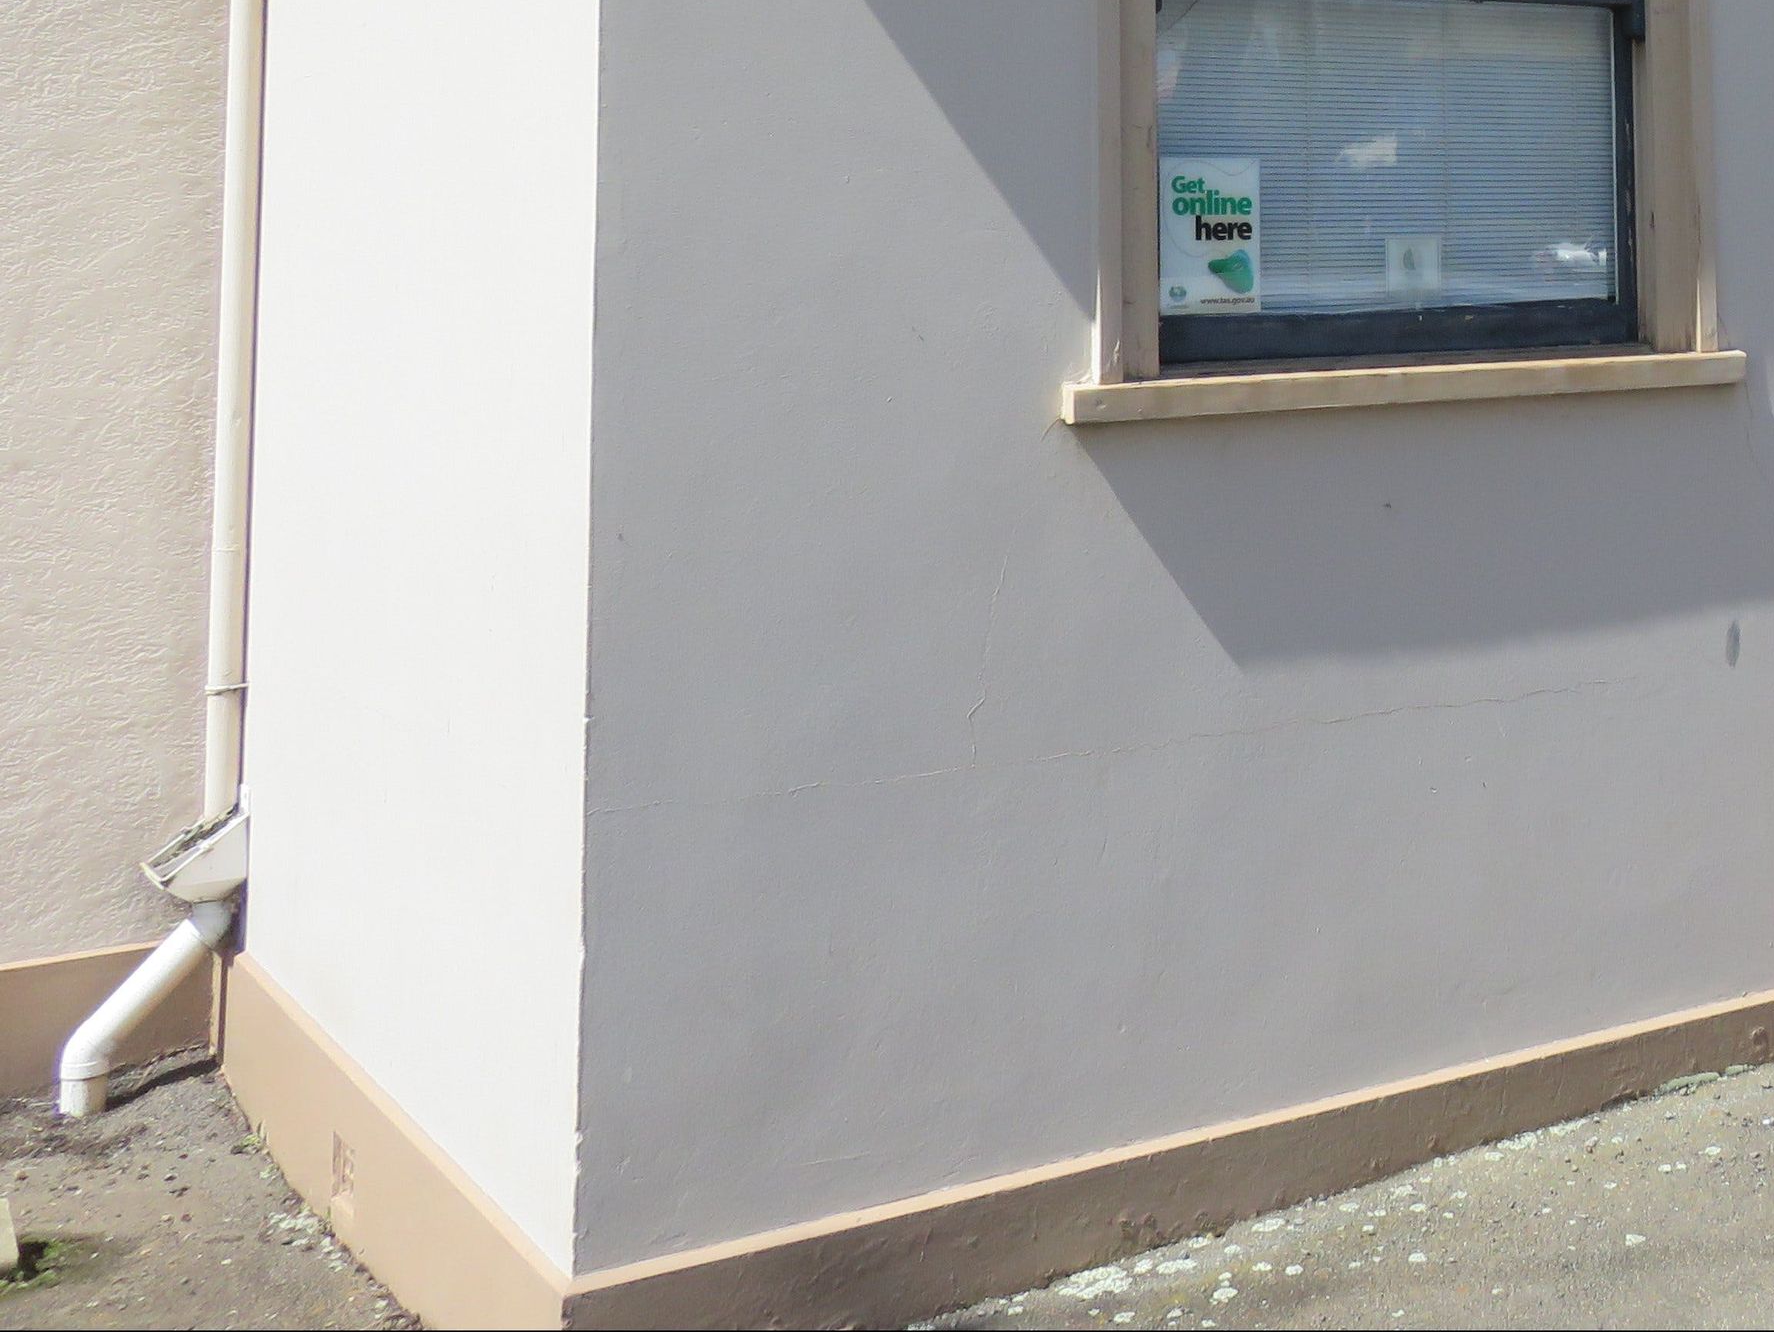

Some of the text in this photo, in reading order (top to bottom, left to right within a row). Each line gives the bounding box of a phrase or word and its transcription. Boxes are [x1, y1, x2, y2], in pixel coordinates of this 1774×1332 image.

[1171, 175, 1205, 194] Get
[1172, 189, 1253, 216] online
[1195, 215, 1253, 241] here
